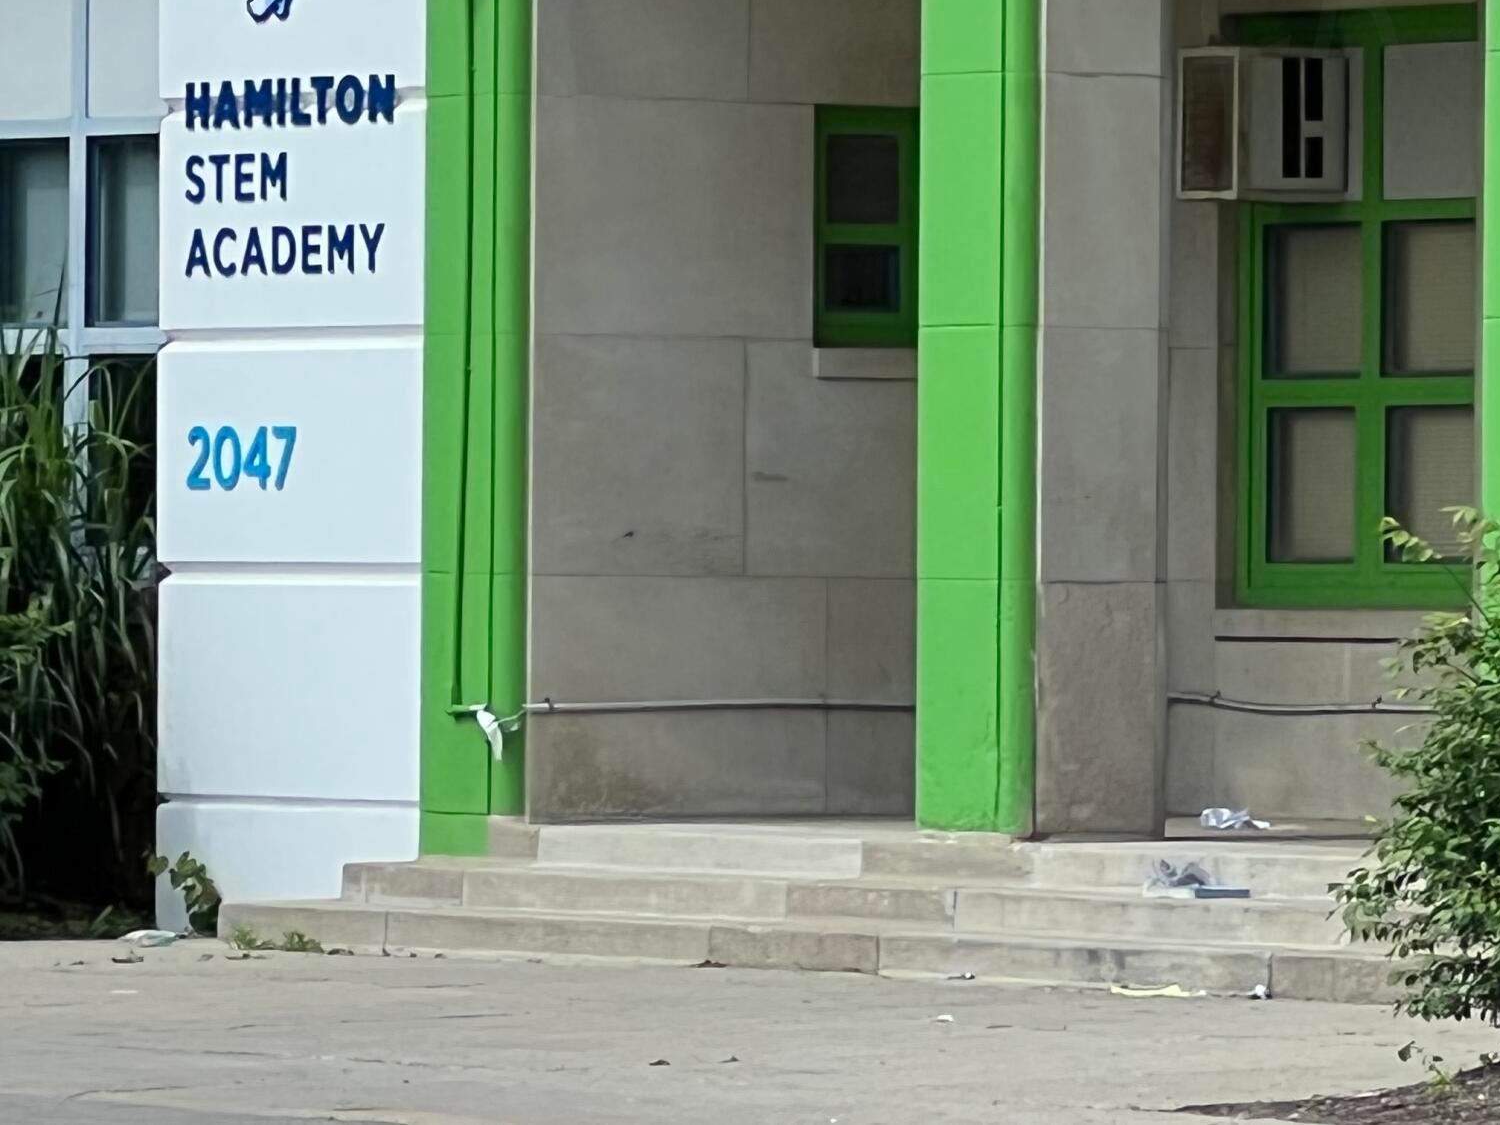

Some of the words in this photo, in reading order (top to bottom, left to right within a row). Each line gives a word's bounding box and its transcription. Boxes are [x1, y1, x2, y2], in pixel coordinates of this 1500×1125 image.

[184, 73, 397, 131] HAMILTON
[185, 151, 288, 205] STEM
[185, 222, 386, 278] ACADEMY
[186, 425, 297, 492] 2047
